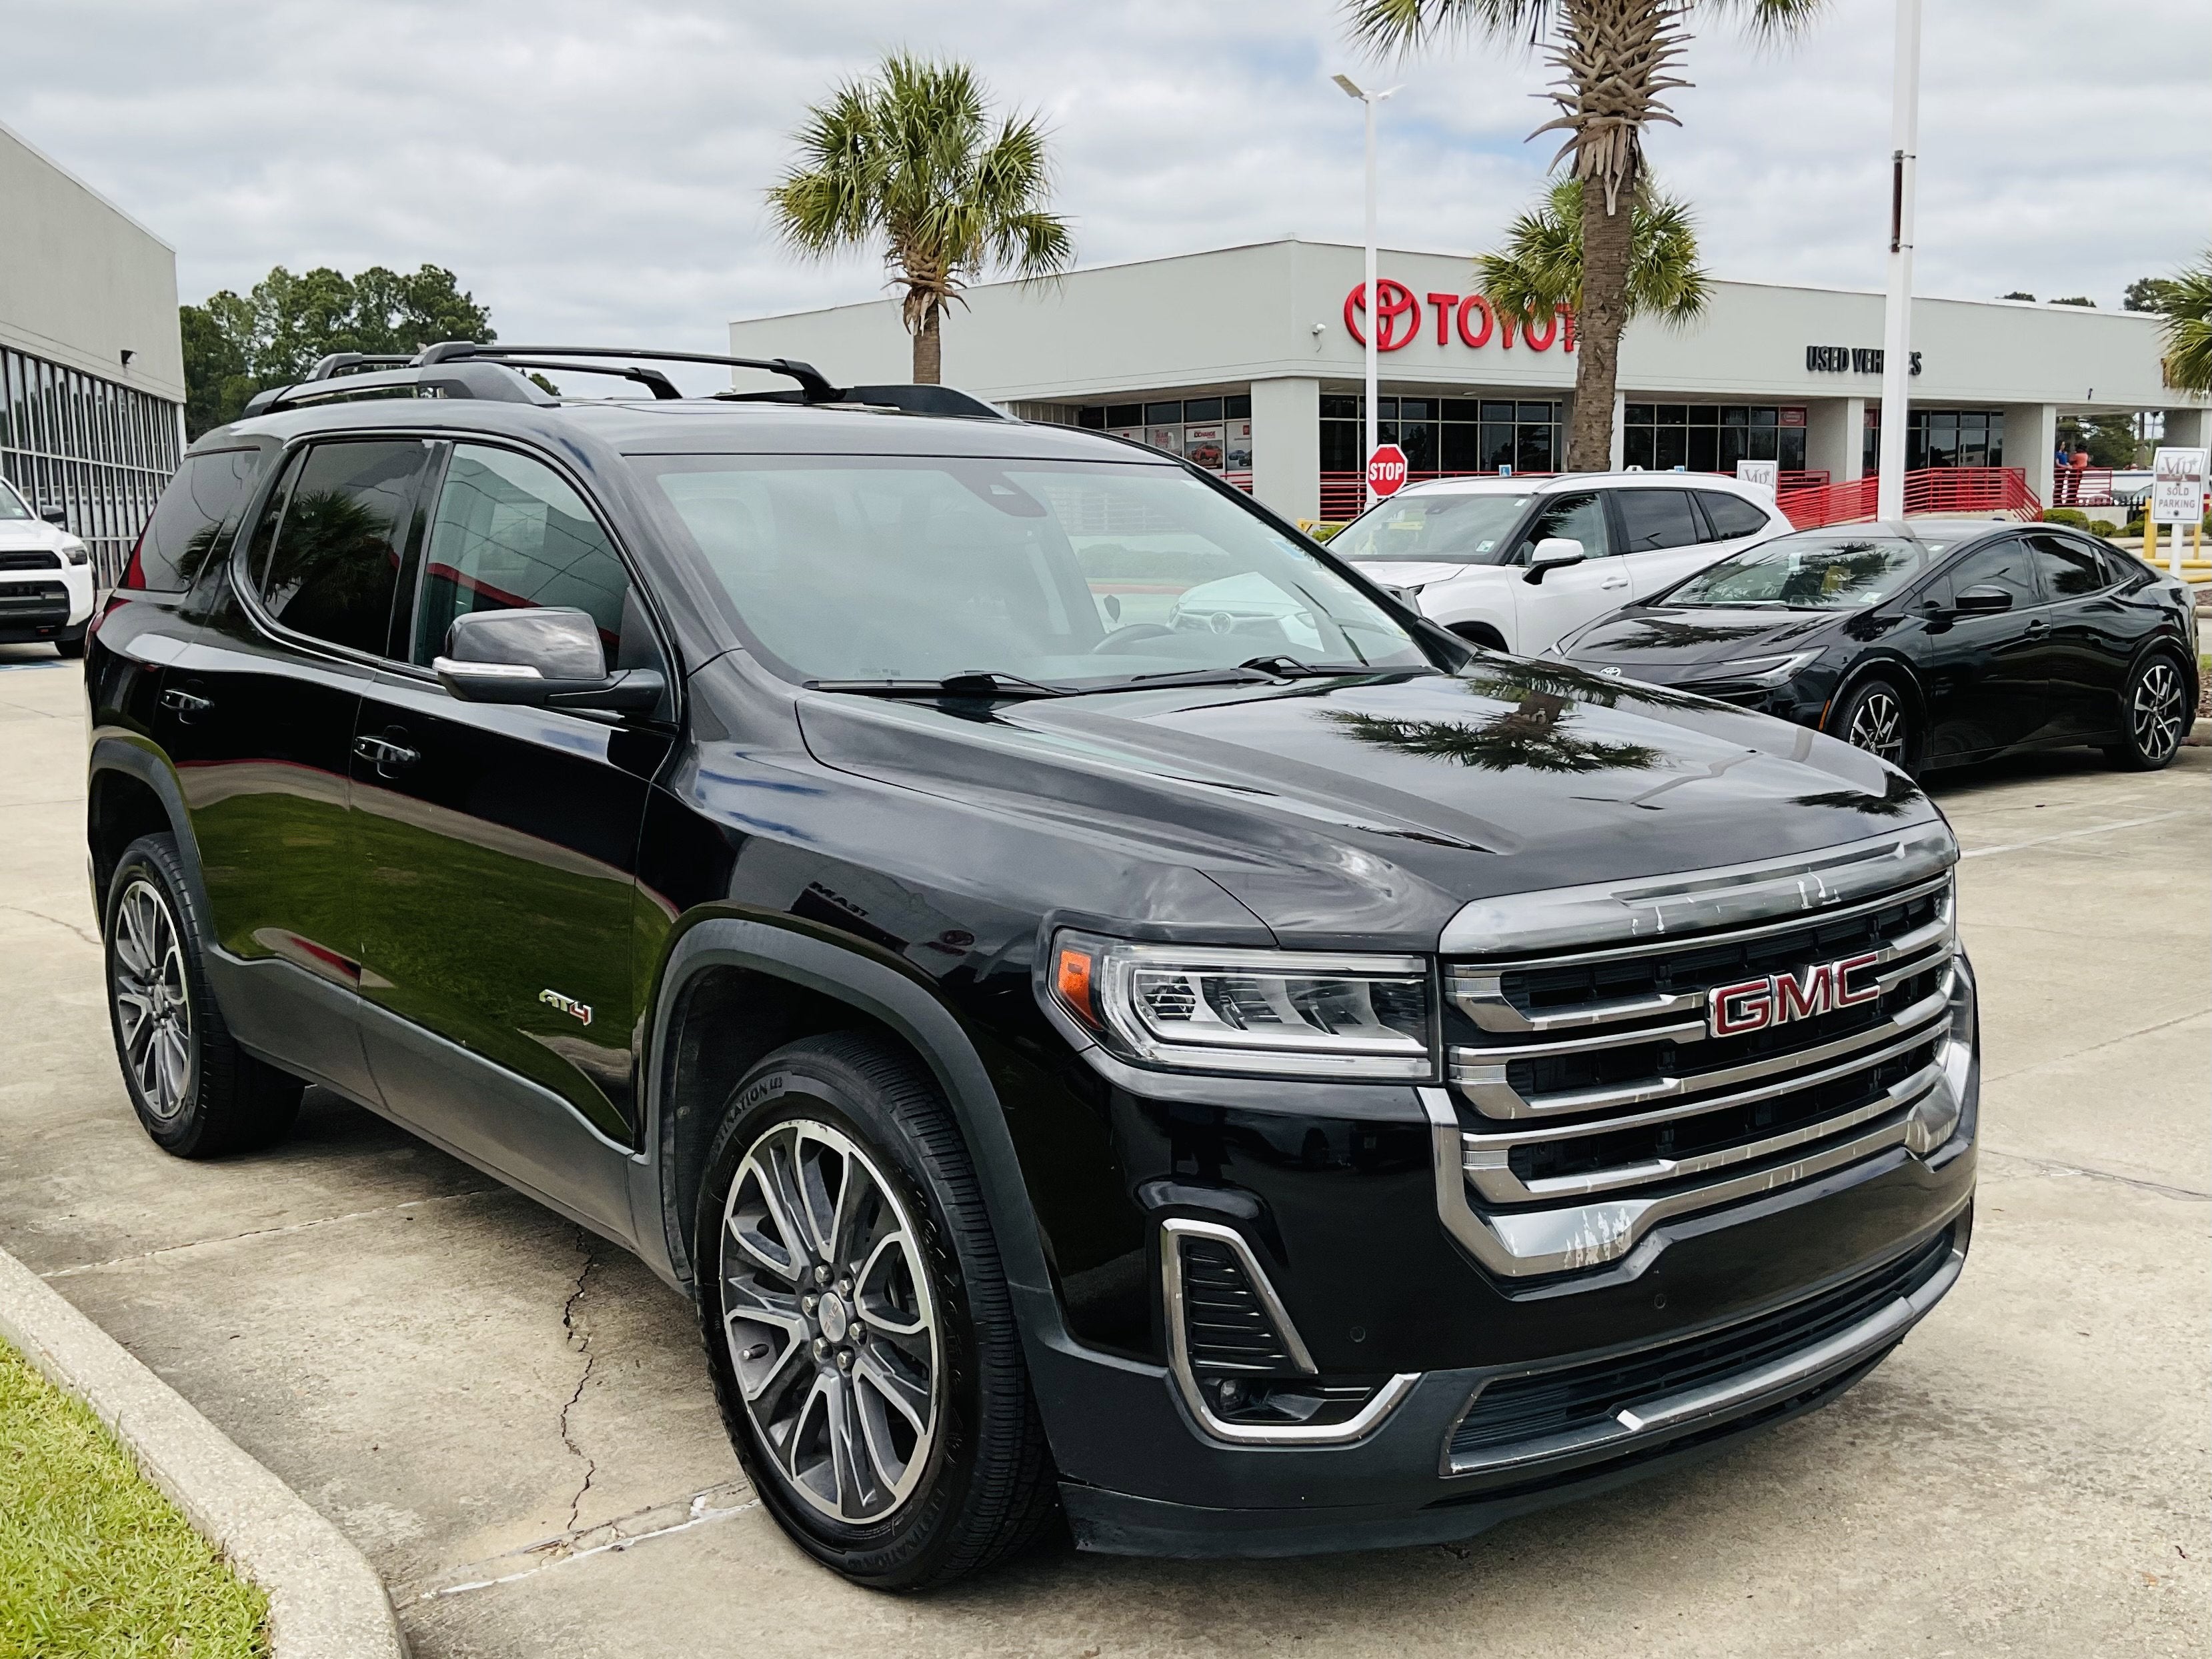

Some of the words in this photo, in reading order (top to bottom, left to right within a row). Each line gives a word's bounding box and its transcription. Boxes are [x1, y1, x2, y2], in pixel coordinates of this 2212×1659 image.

[1427, 292, 1578, 352] TOYOT
[1807, 346, 1849, 371] USED
[1852, 348, 1922, 375] VEHS
[1369, 462, 1404, 481] STOP
[2159, 499, 2195, 507] PARKING
[2167, 487, 2189, 495] SOLD
[539, 989, 593, 1026] AT4
[1709, 951, 1880, 1038] GMC
